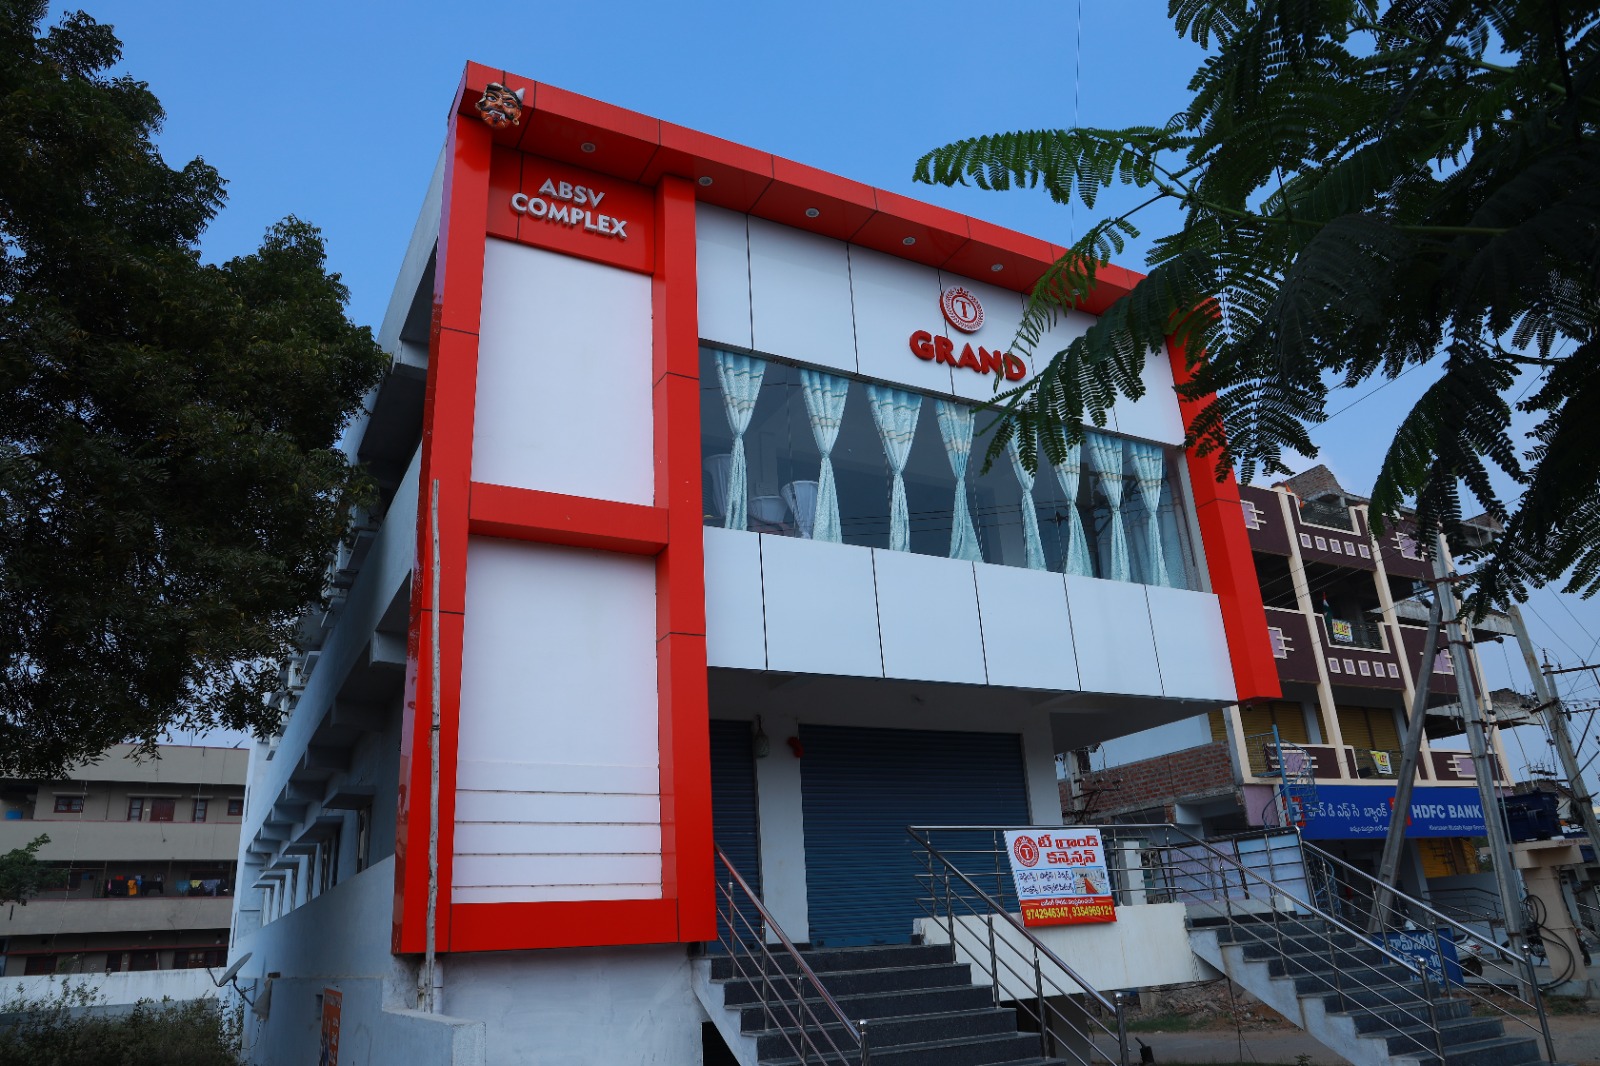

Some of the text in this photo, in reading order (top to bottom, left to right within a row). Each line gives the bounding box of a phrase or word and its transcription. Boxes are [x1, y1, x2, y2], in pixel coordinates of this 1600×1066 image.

[538, 178, 605, 208] ABSV
[510, 192, 628, 240] COMPLEX
[909, 329, 1027, 381] GRAND
[1412, 804, 1483, 819] HDFC BANK
